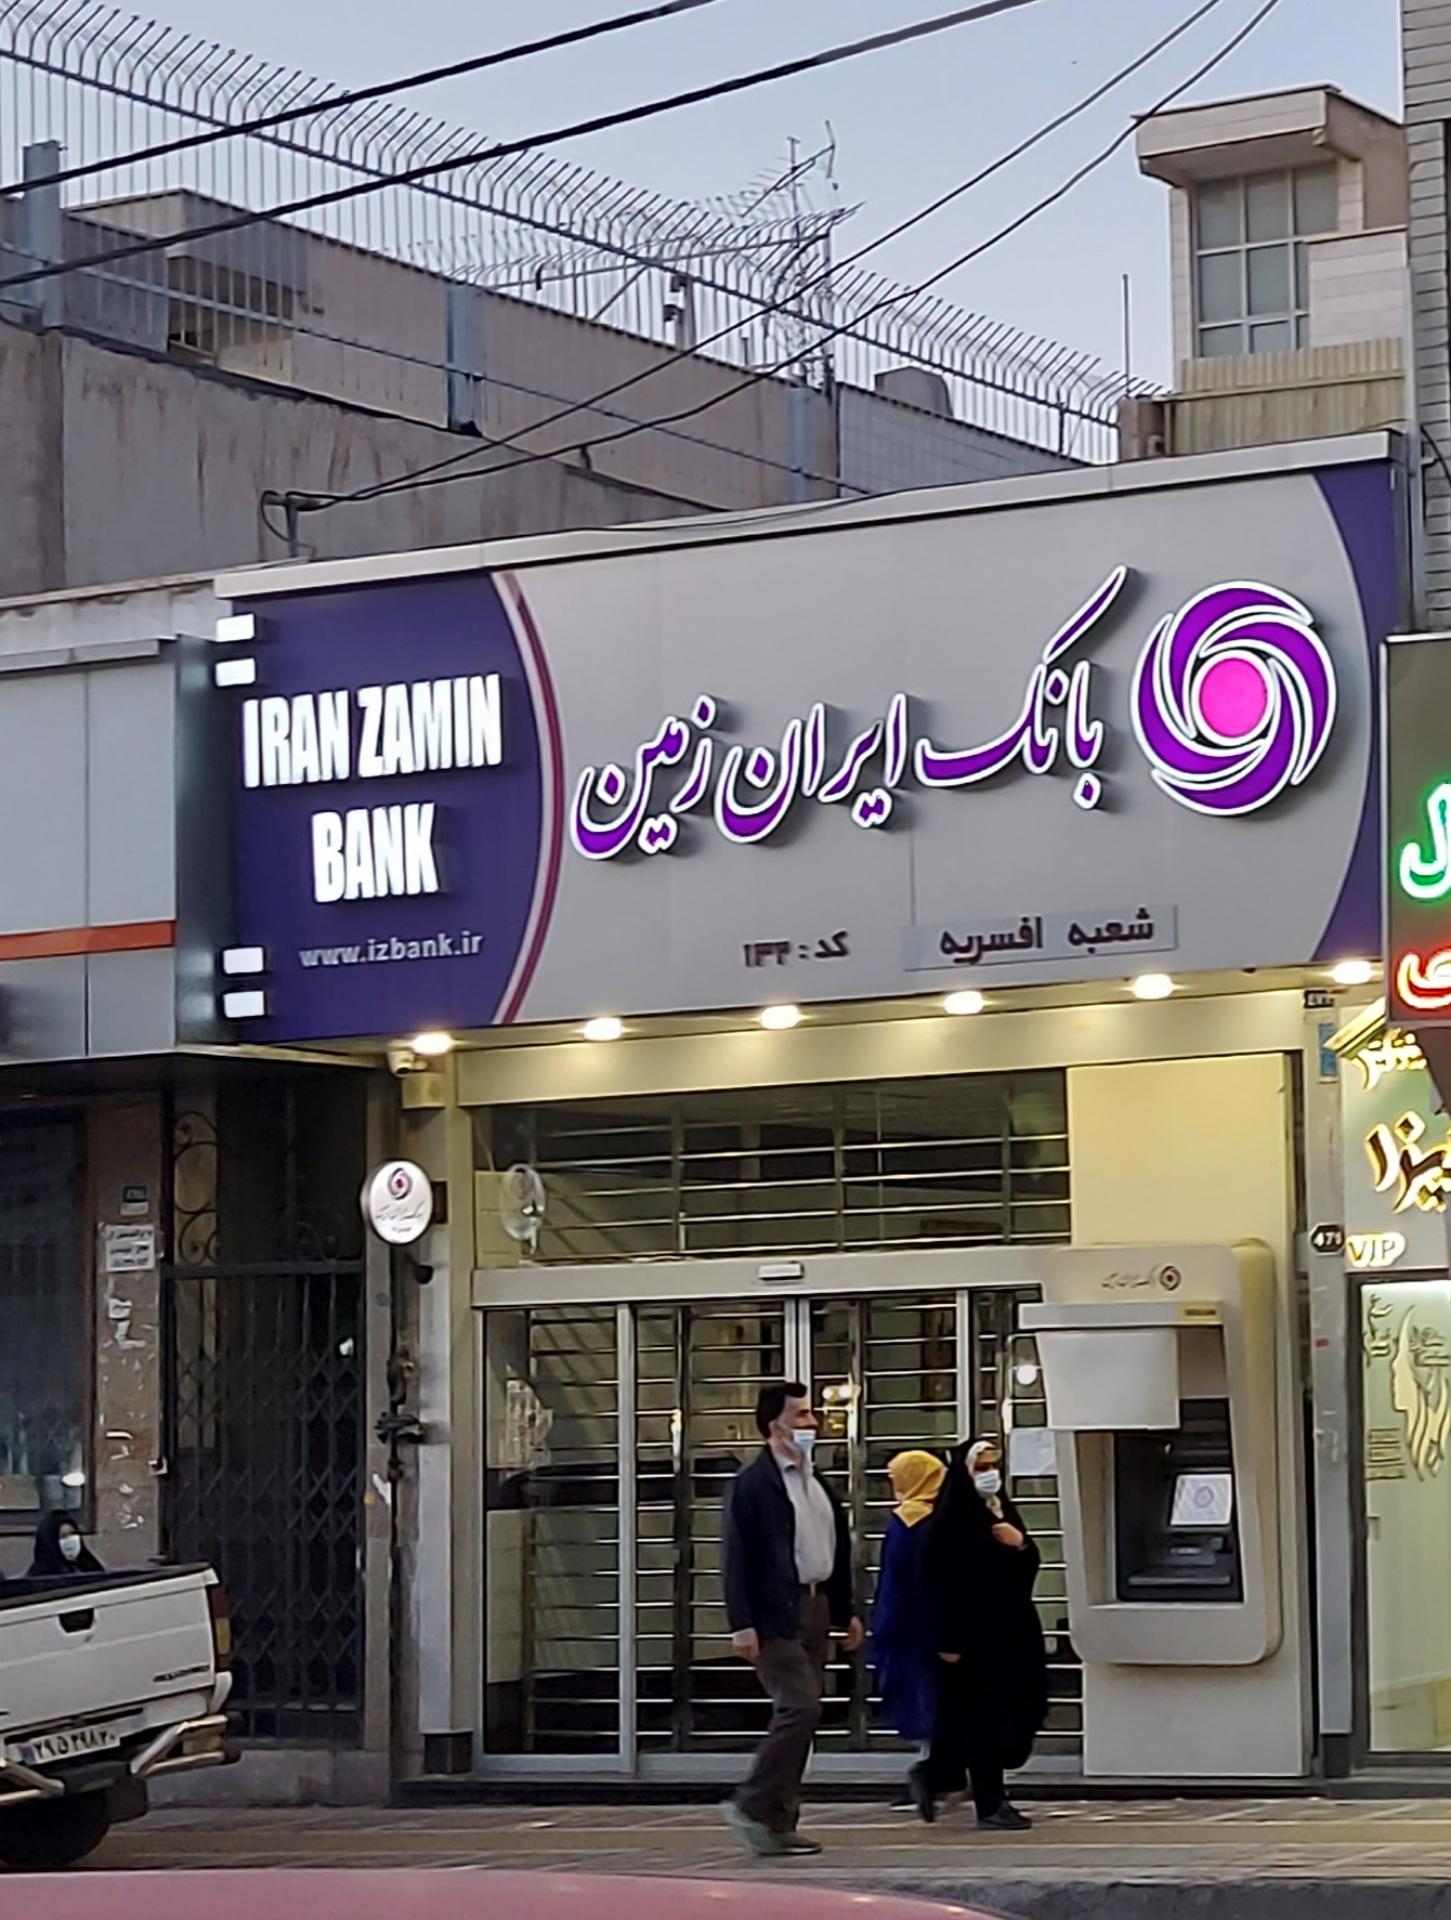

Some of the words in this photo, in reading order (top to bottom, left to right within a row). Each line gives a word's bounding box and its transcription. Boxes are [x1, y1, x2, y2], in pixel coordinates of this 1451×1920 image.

[243, 689, 351, 788] IRAN
[356, 672, 503, 780] ZAMIN
[914, 564, 1128, 812] بانک
[569, 695, 716, 861] زمین
[714, 692, 909, 843] ایران
[311, 802, 440, 903] BANK
[299, 930, 484, 968] www.izbank.ir
[939, 916, 1043, 966] افسریه
[1066, 906, 1155, 954] شعبه
[1346, 1234, 1402, 1266] VIP
